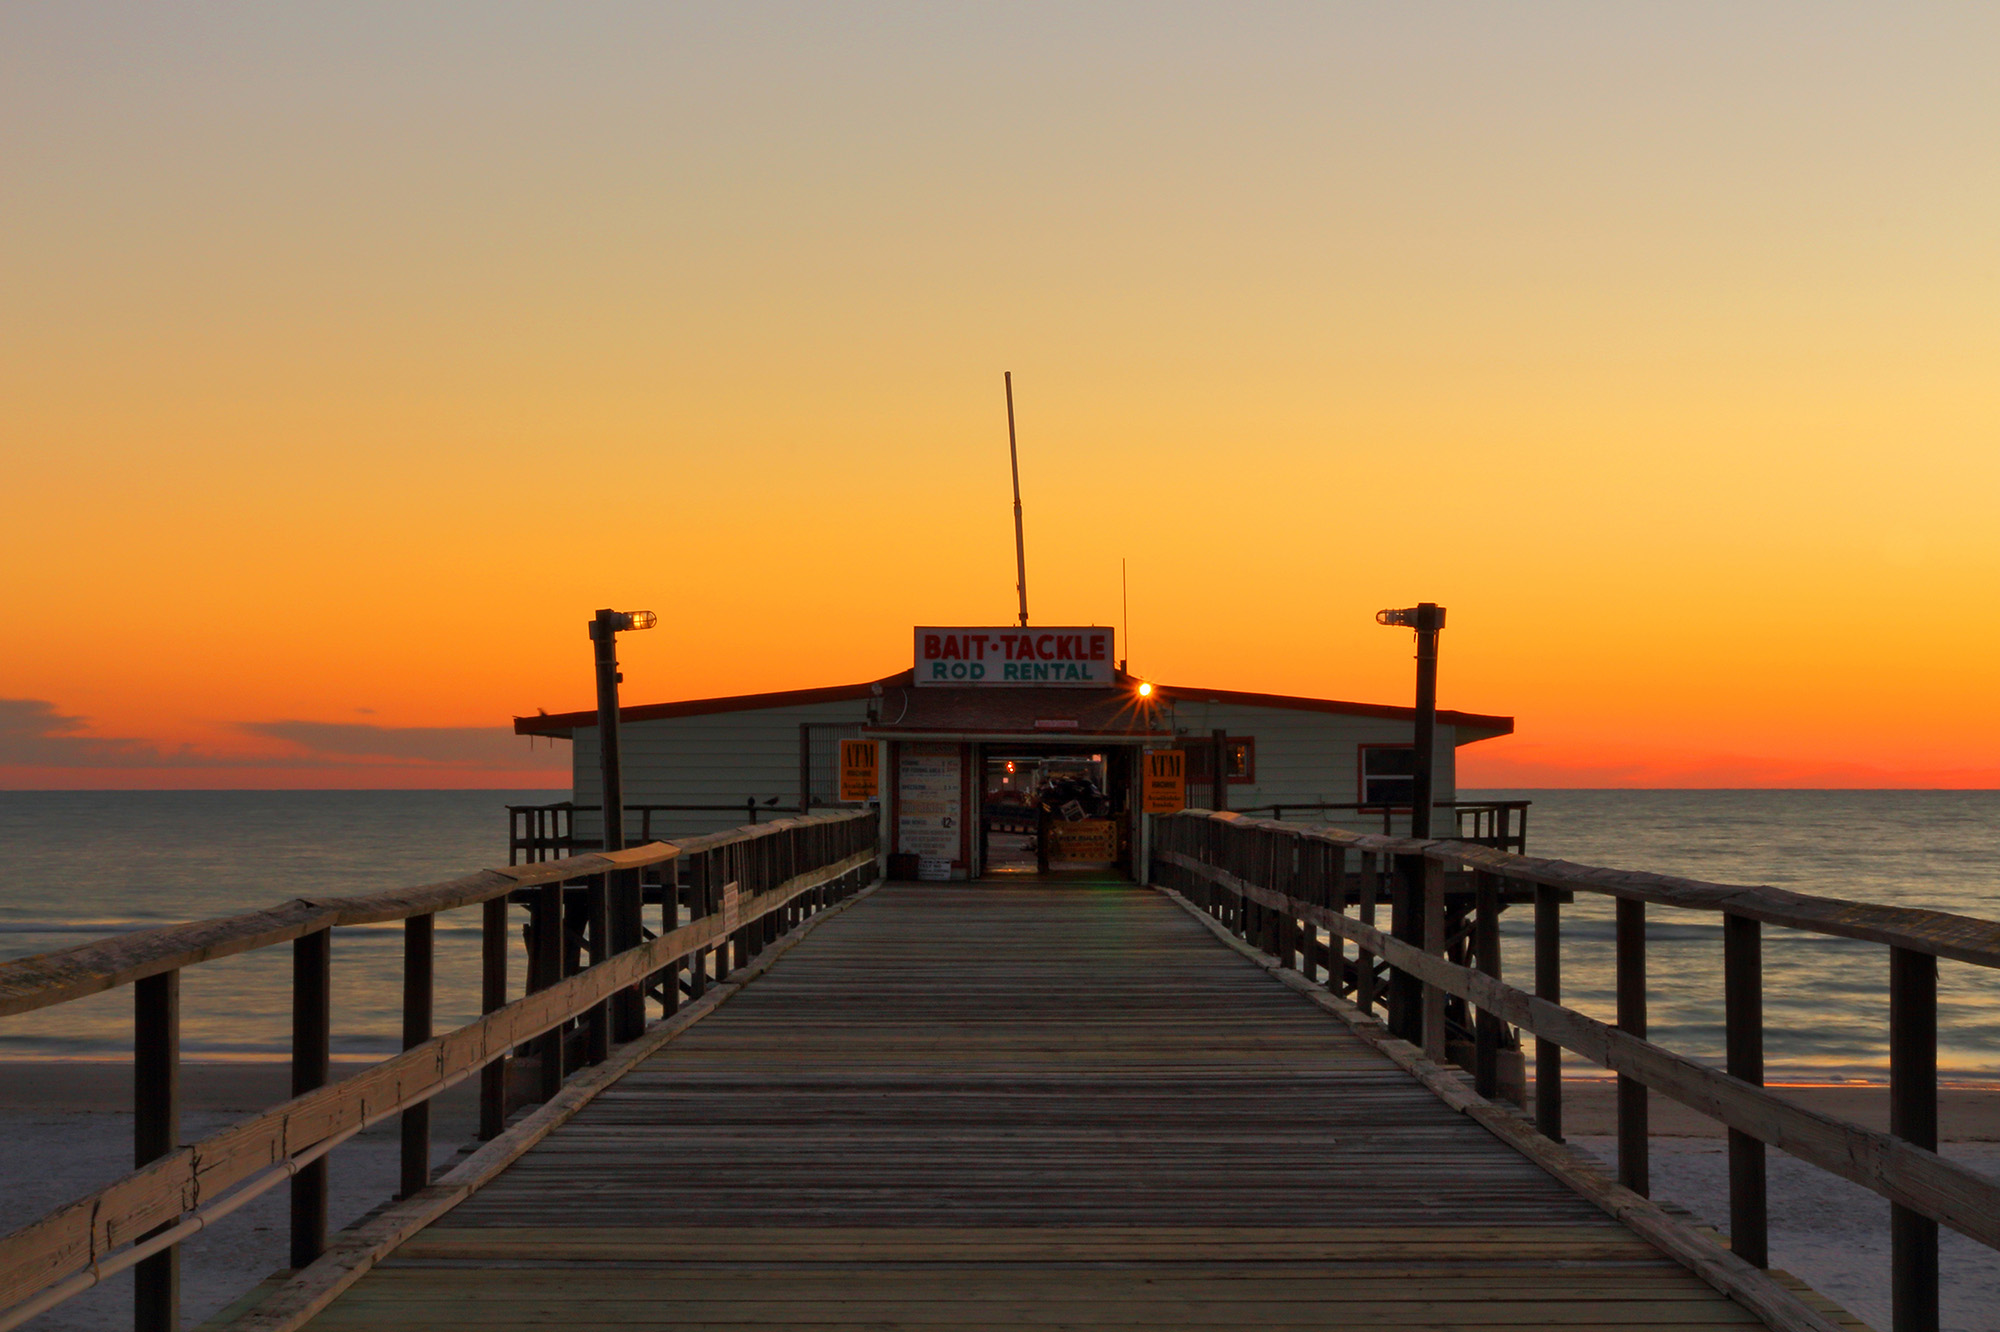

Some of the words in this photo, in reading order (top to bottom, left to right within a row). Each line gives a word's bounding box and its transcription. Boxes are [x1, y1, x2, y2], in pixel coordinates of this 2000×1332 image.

[924, 634, 989, 660] BAIT
[1000, 635, 1105, 660] TACKLE
[932, 662, 985, 679] ROD
[1004, 663, 1093, 680] RENTAL
[845, 743, 874, 767] ATM
[1147, 755, 1181, 776] ATM
